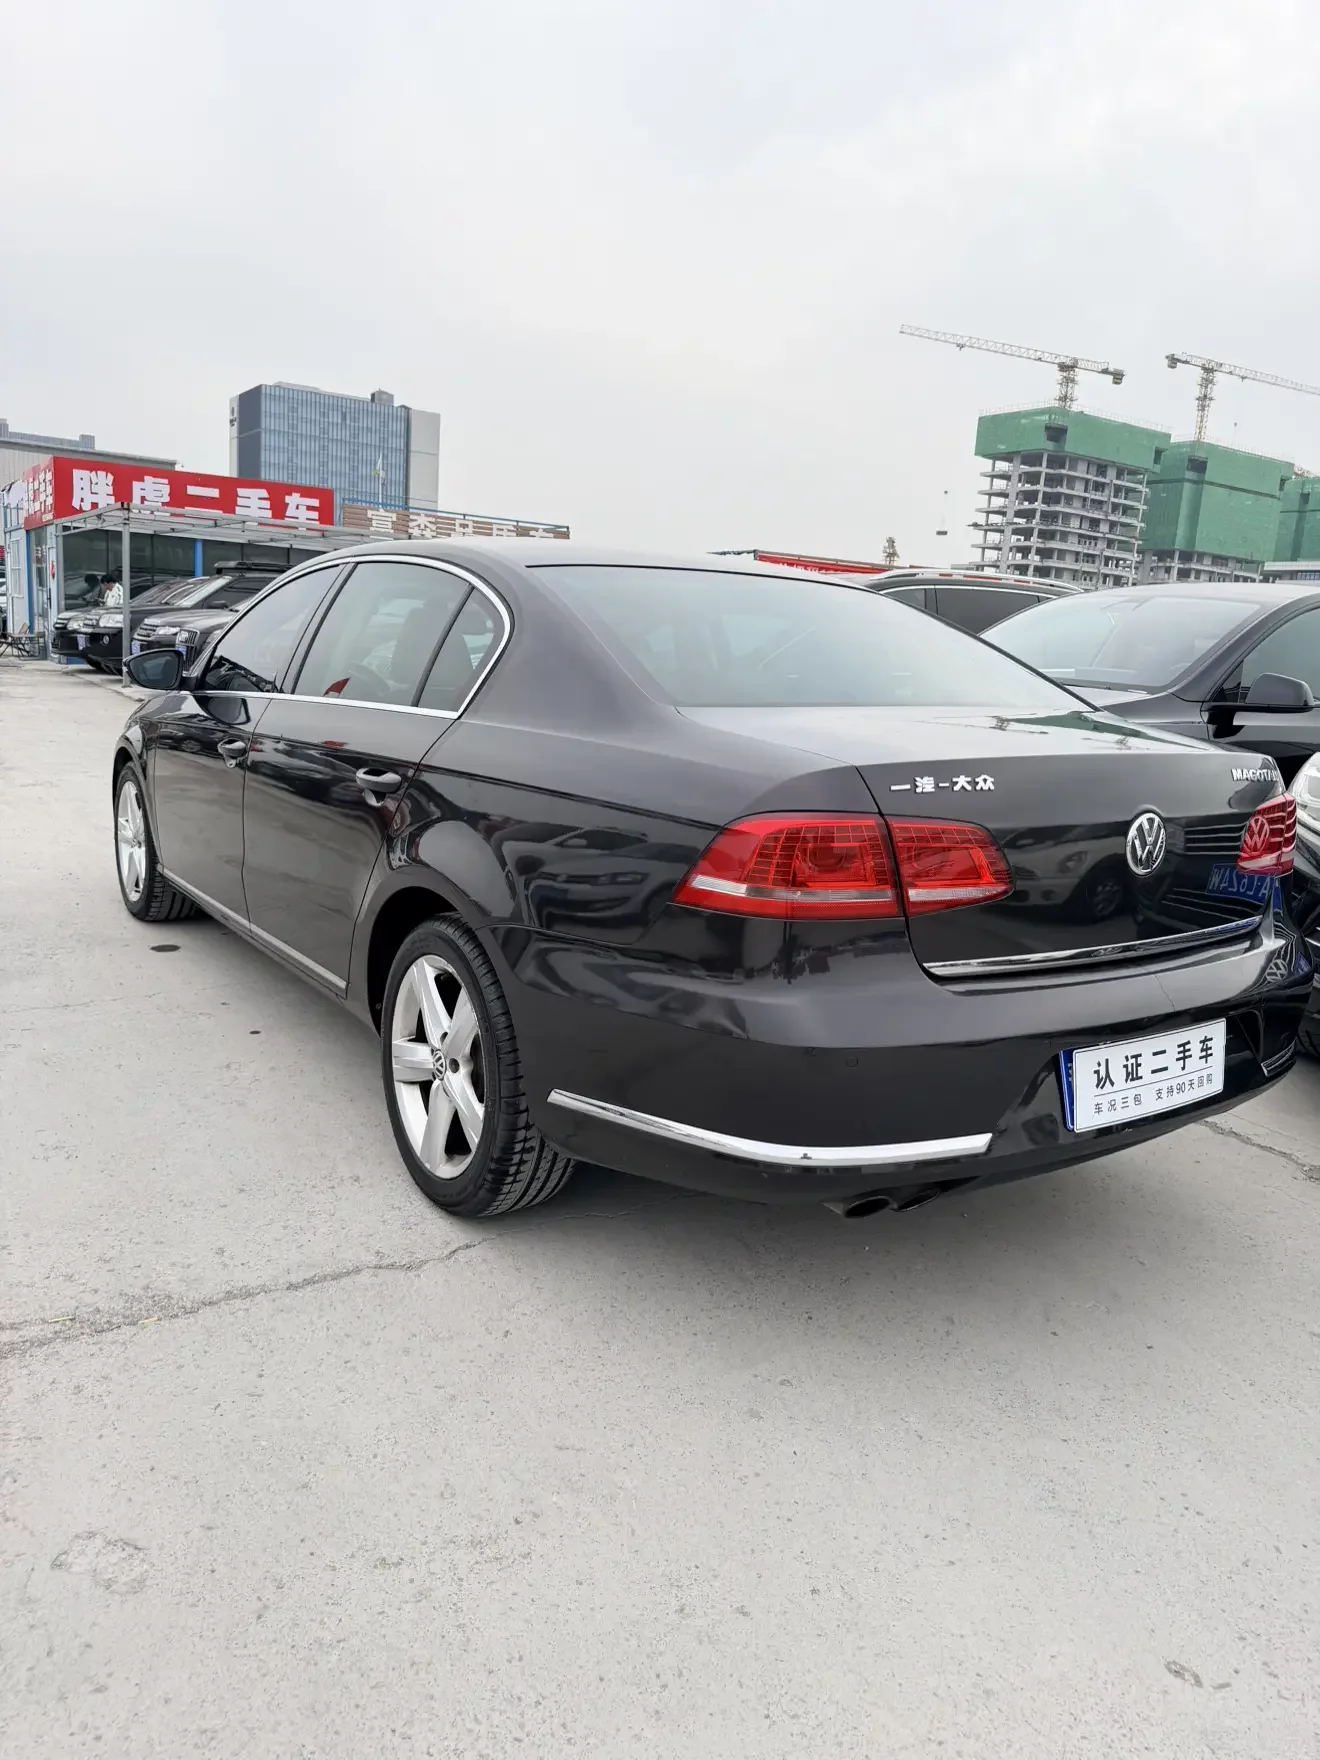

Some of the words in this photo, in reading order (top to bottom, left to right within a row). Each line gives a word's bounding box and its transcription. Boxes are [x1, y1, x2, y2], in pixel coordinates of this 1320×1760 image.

[72, 469, 320, 531] 胖虎二手车
[1093, 1035, 1214, 1090] 认证二手车
[1094, 1093, 1143, 1115] 车况三包
[1155, 1073, 1213, 1101] 支持90天回购
